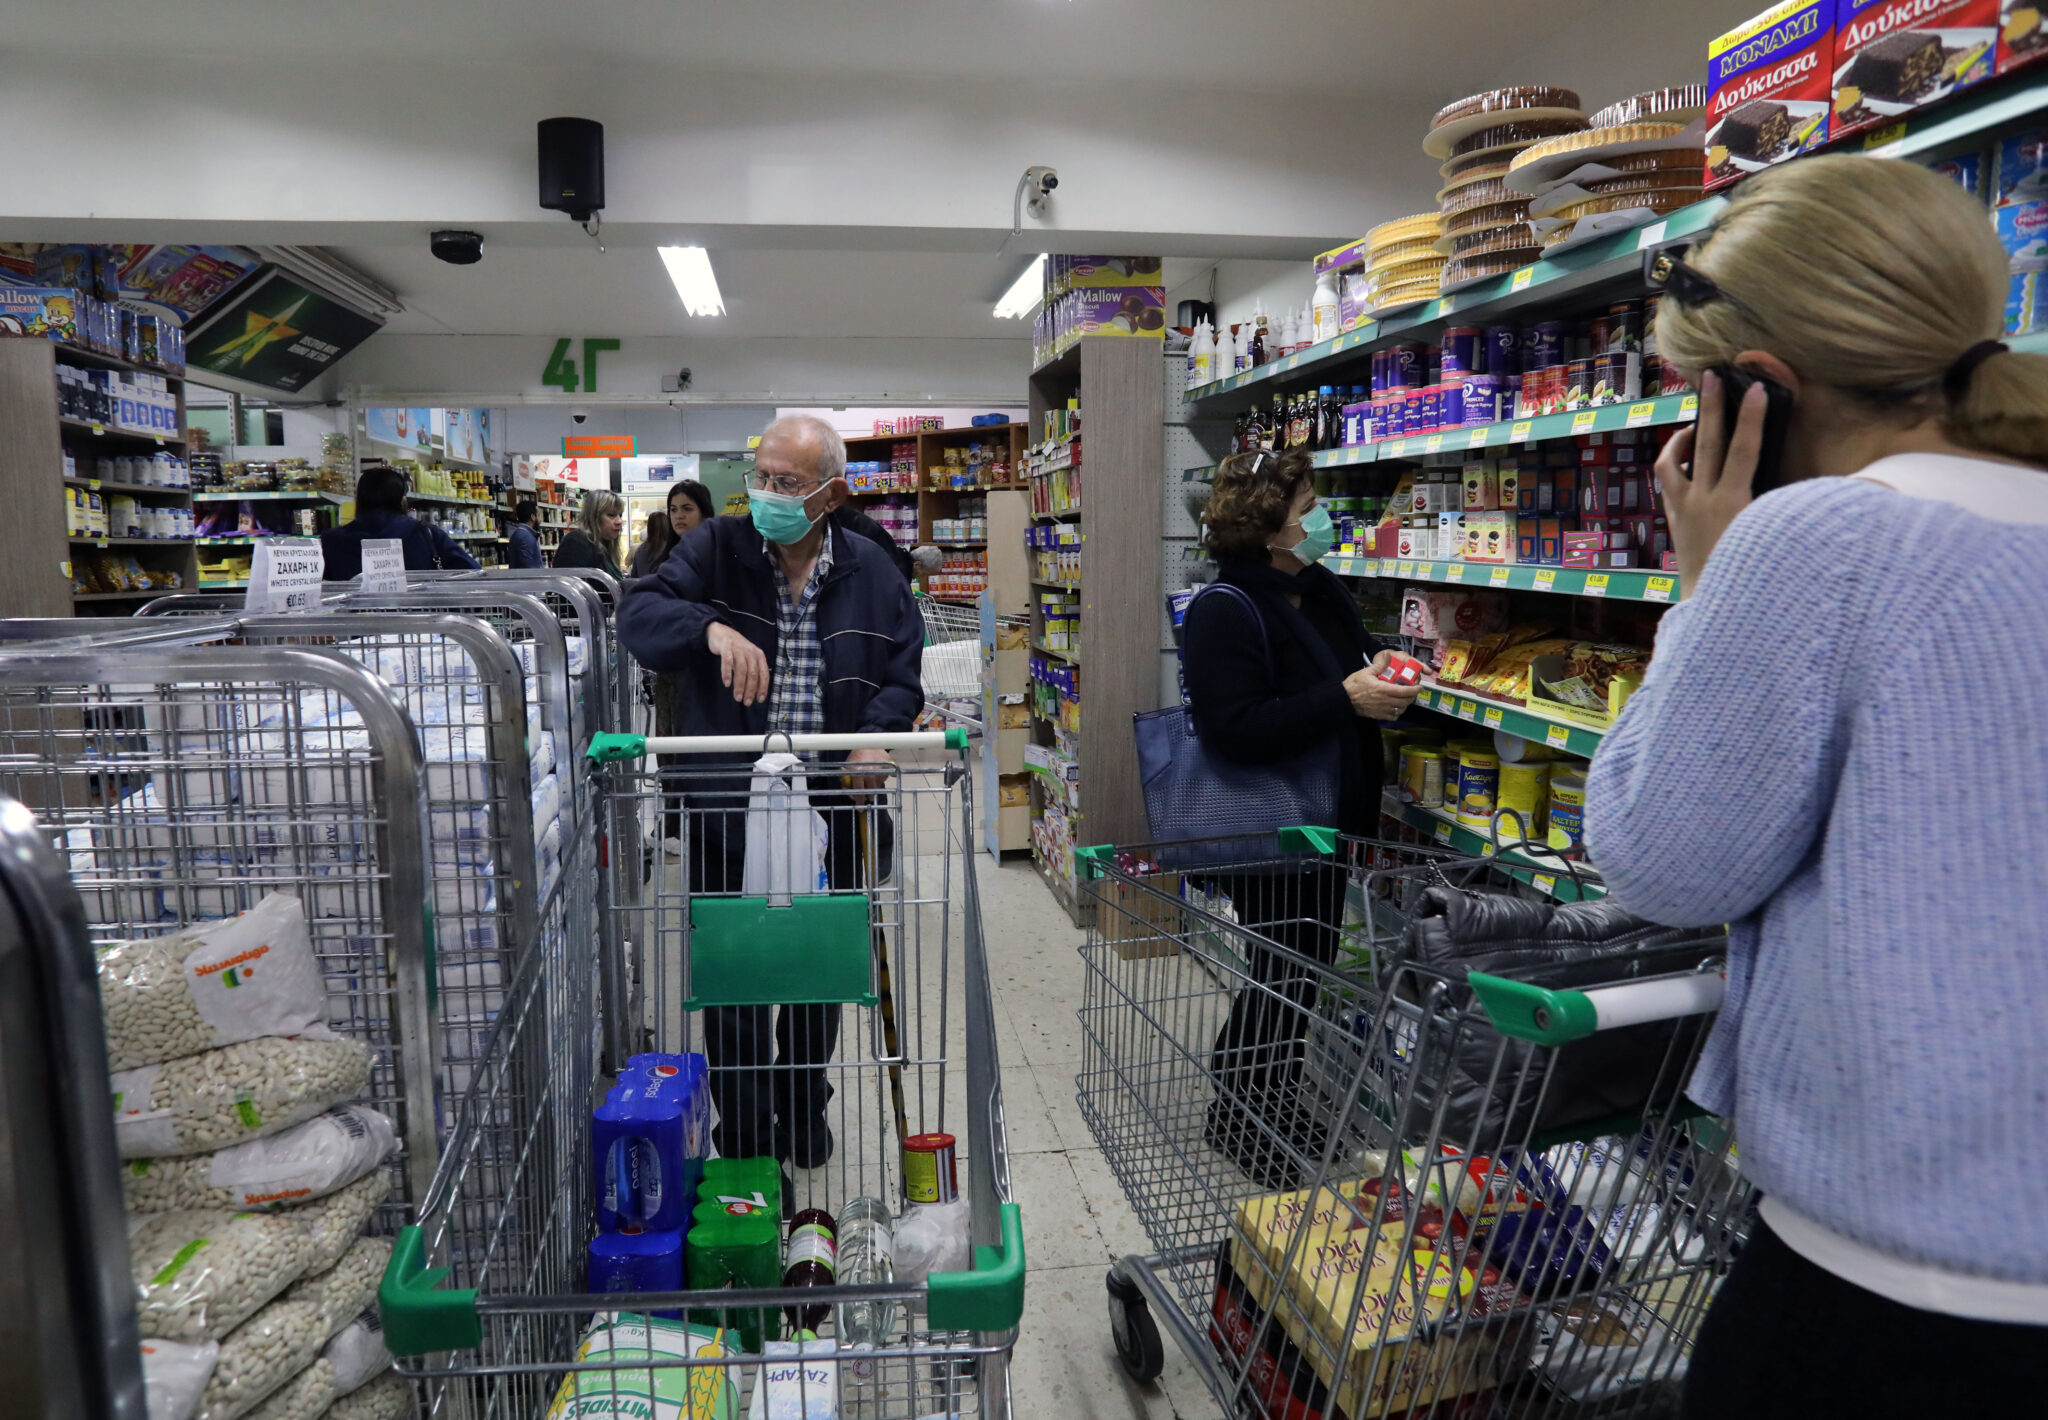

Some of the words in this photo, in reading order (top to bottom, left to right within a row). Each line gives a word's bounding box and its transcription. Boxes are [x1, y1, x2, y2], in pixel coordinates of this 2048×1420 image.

[1843, 0, 1953, 51] Δούκισ
[1720, 9, 1819, 78] MONAMI
[1714, 51, 1818, 114] Δούκισσα
[1079, 289, 1122, 302] Mallow
[277, 562, 308, 575] ΖΑΧΑΡΗ
[270, 578, 289, 587] WHITE
[1651, 578, 1668, 587] €1.35
[287, 593, 306, 608] €0.63
[1317, 1239, 1362, 1261] Diet
